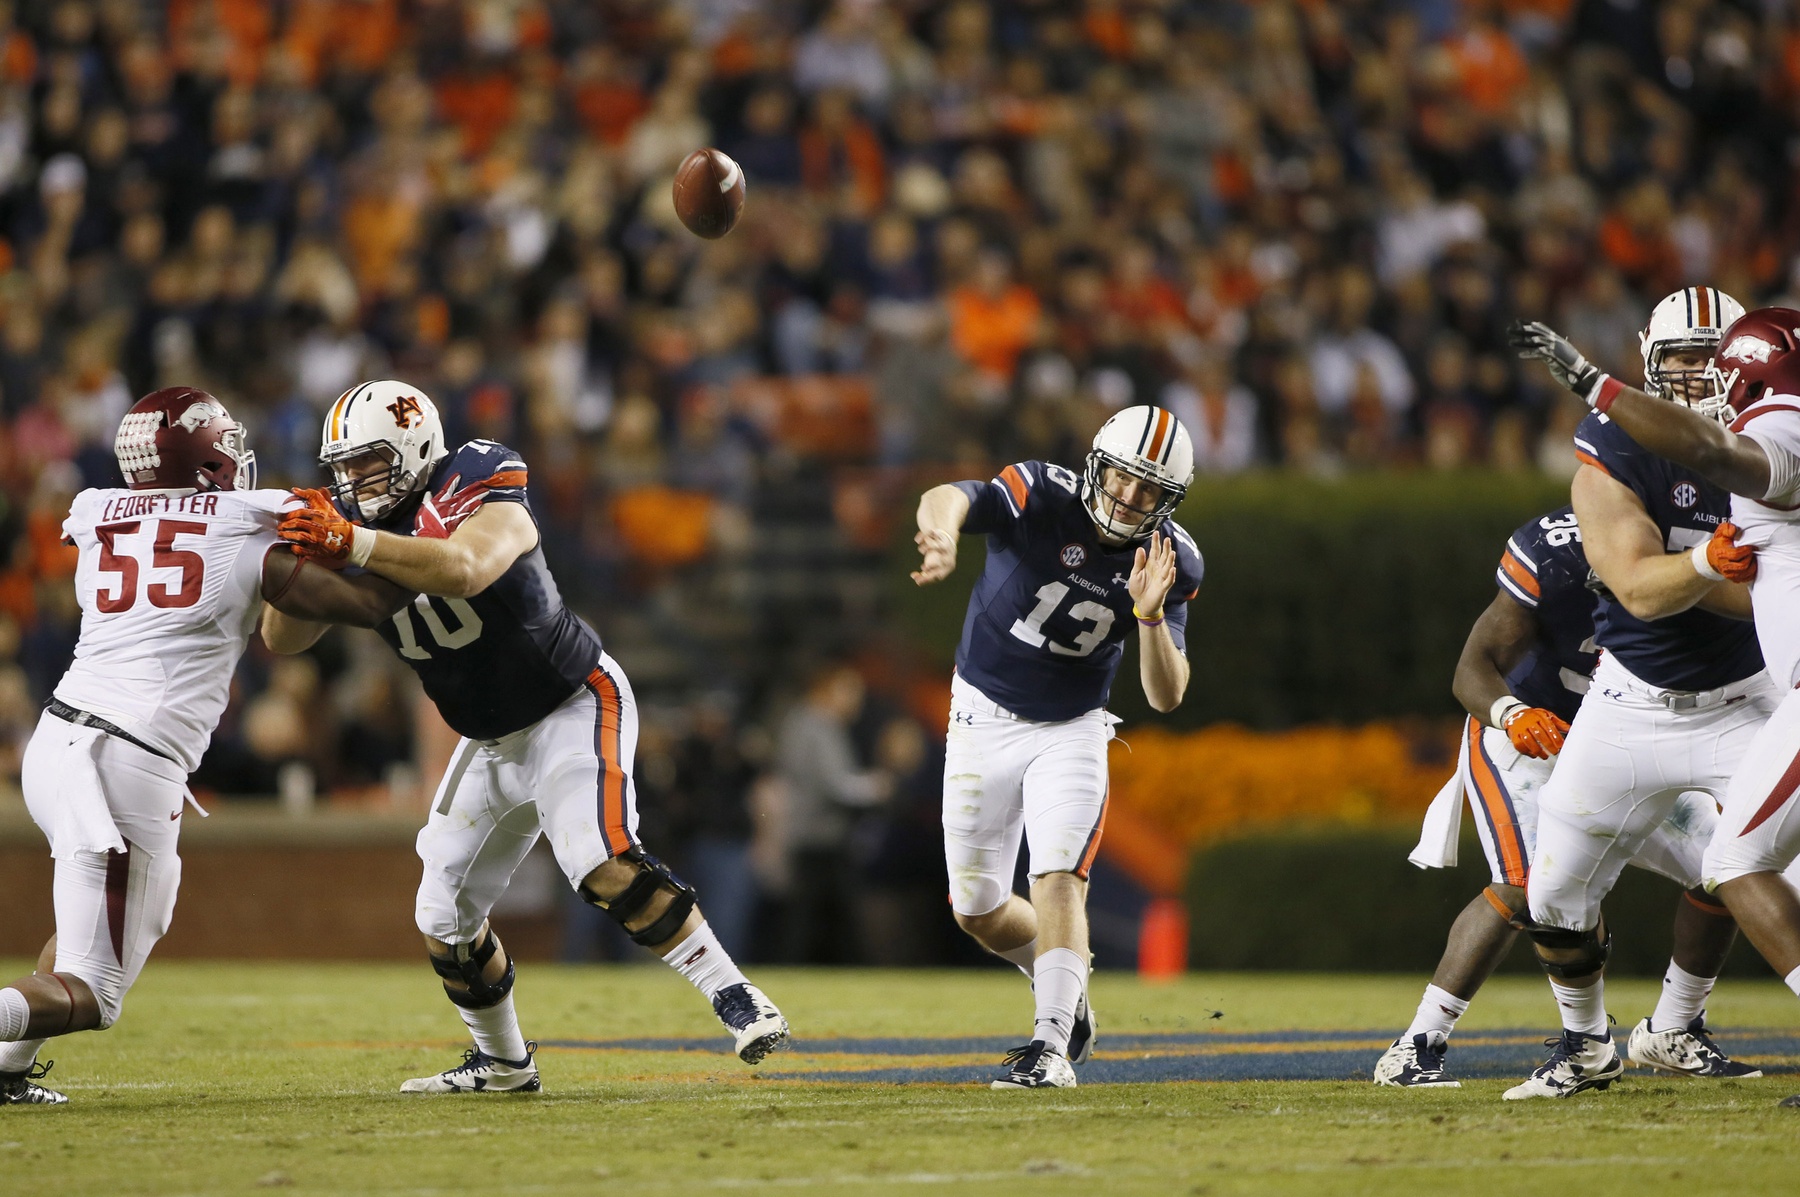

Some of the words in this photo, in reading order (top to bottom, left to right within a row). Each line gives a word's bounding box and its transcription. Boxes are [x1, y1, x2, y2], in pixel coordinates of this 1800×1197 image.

[1139, 459, 1158, 471] TIGERS
[1673, 483, 1697, 508] SEC
[1539, 513, 1582, 547] 36
[95, 519, 208, 614] 55
[1062, 545, 1085, 567] SEC
[1067, 572, 1109, 597] AUBURN
[1009, 580, 1116, 657] 13
[90, 719, 117, 732] NIKE
